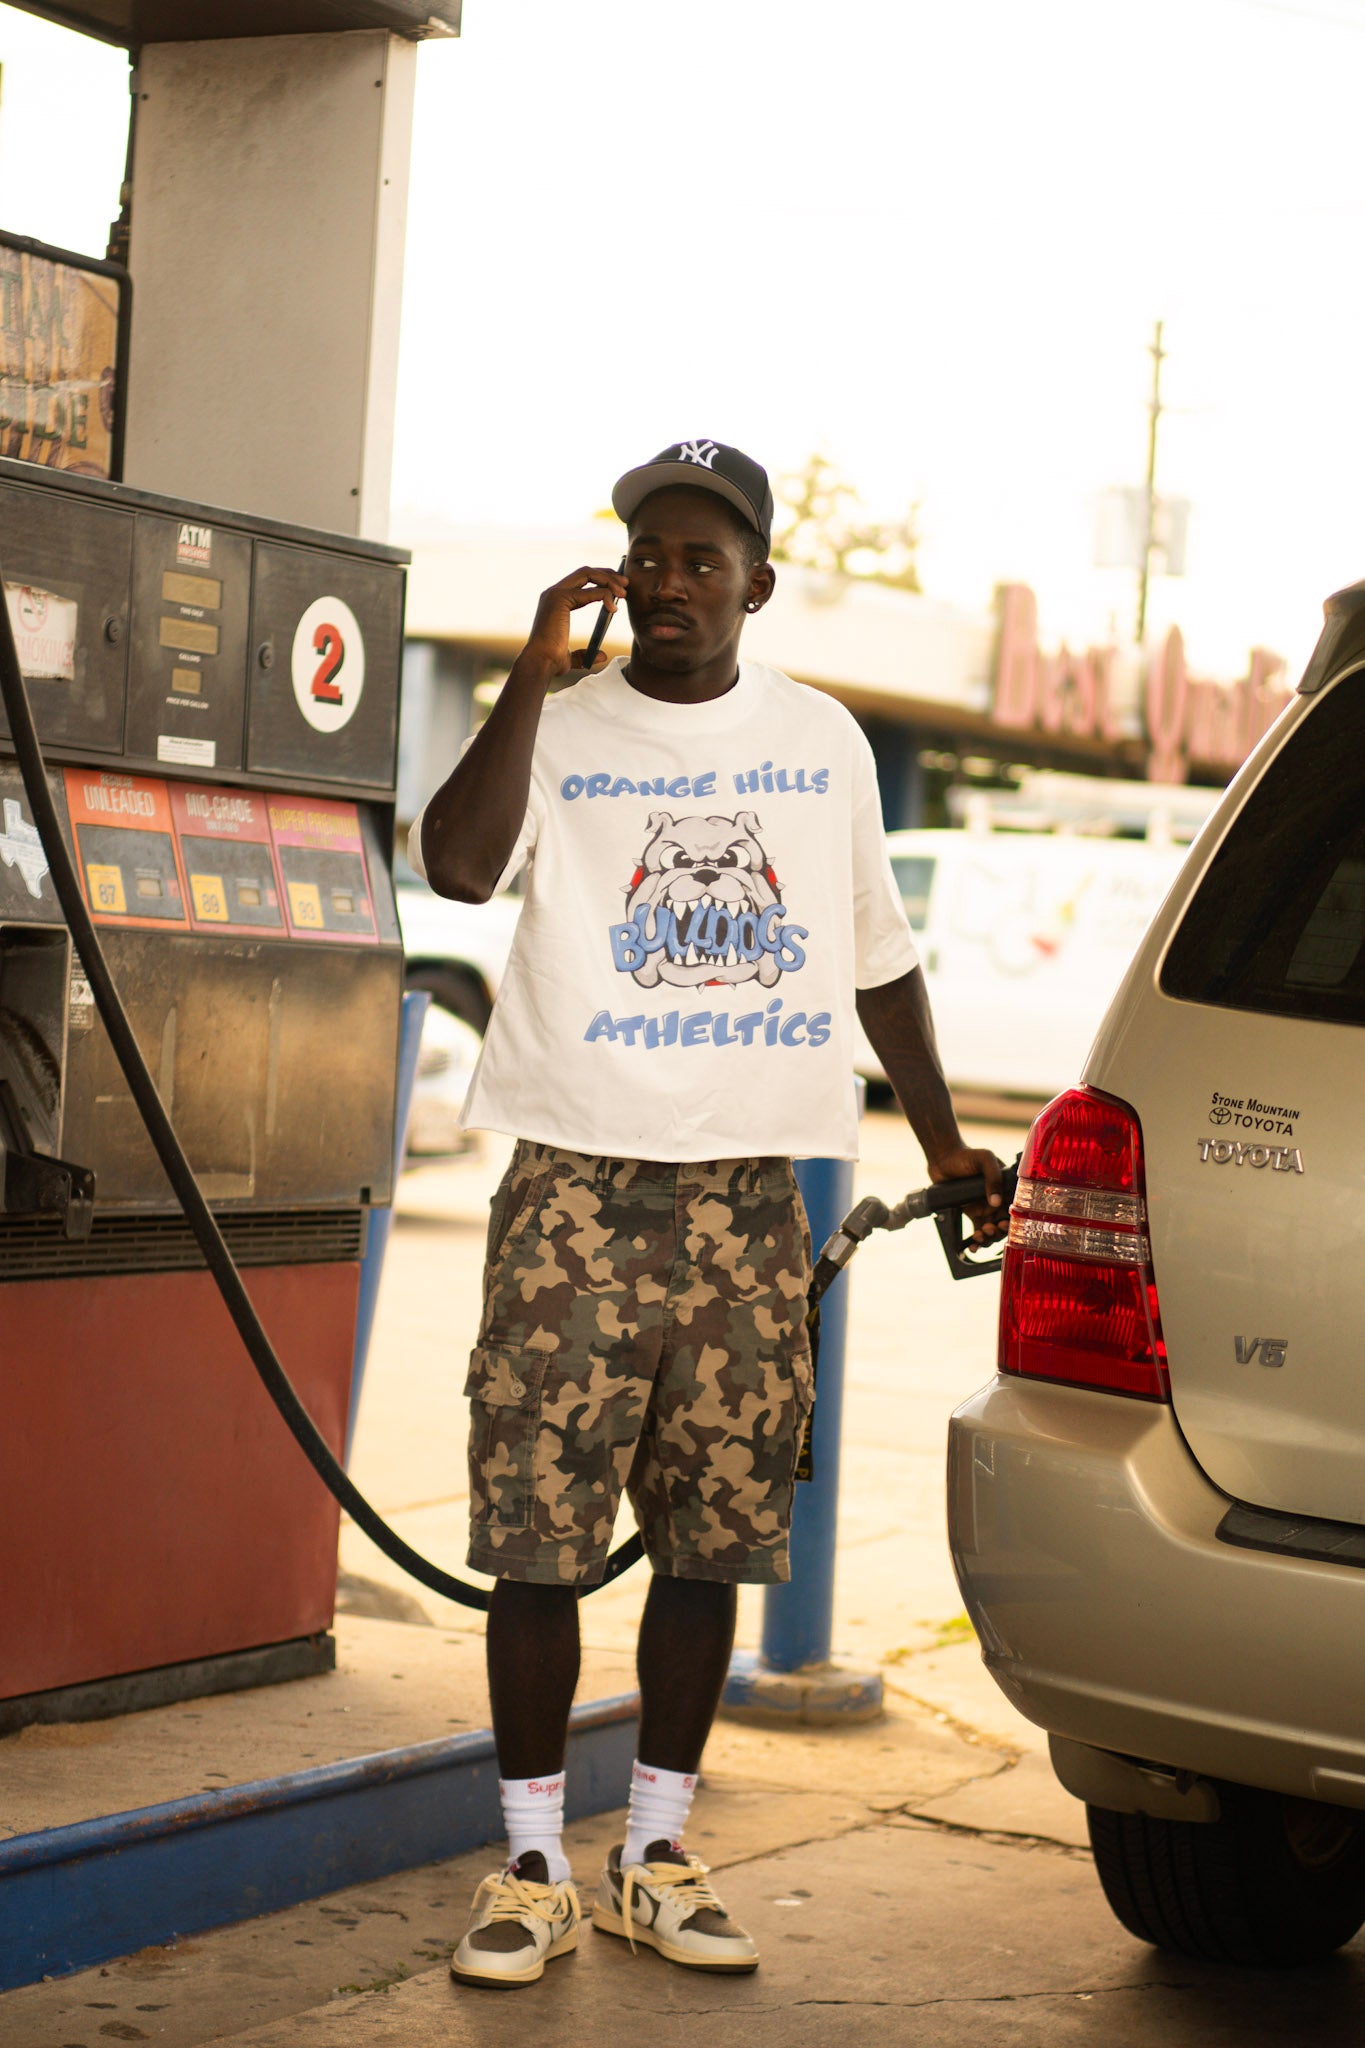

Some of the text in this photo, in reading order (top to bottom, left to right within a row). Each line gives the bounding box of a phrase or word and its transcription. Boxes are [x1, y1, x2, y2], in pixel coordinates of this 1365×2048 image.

[179, 524, 212, 549] ATM
[310, 623, 345, 706] 2
[83, 784, 155, 817] UNLEADED
[560, 771, 717, 801] ORANGE
[185, 793, 254, 823] MID-GRADE
[269, 807, 358, 838] SUPER PREMIUM
[99, 883, 117, 905] 87
[201, 892, 221, 915] 89
[608, 902, 810, 973] BULLDOGS
[1234, 1113, 1293, 1136] TOYOTA
[1197, 1138, 1304, 1174] TOYOTA
[1234, 1335, 1288, 1368] V6
